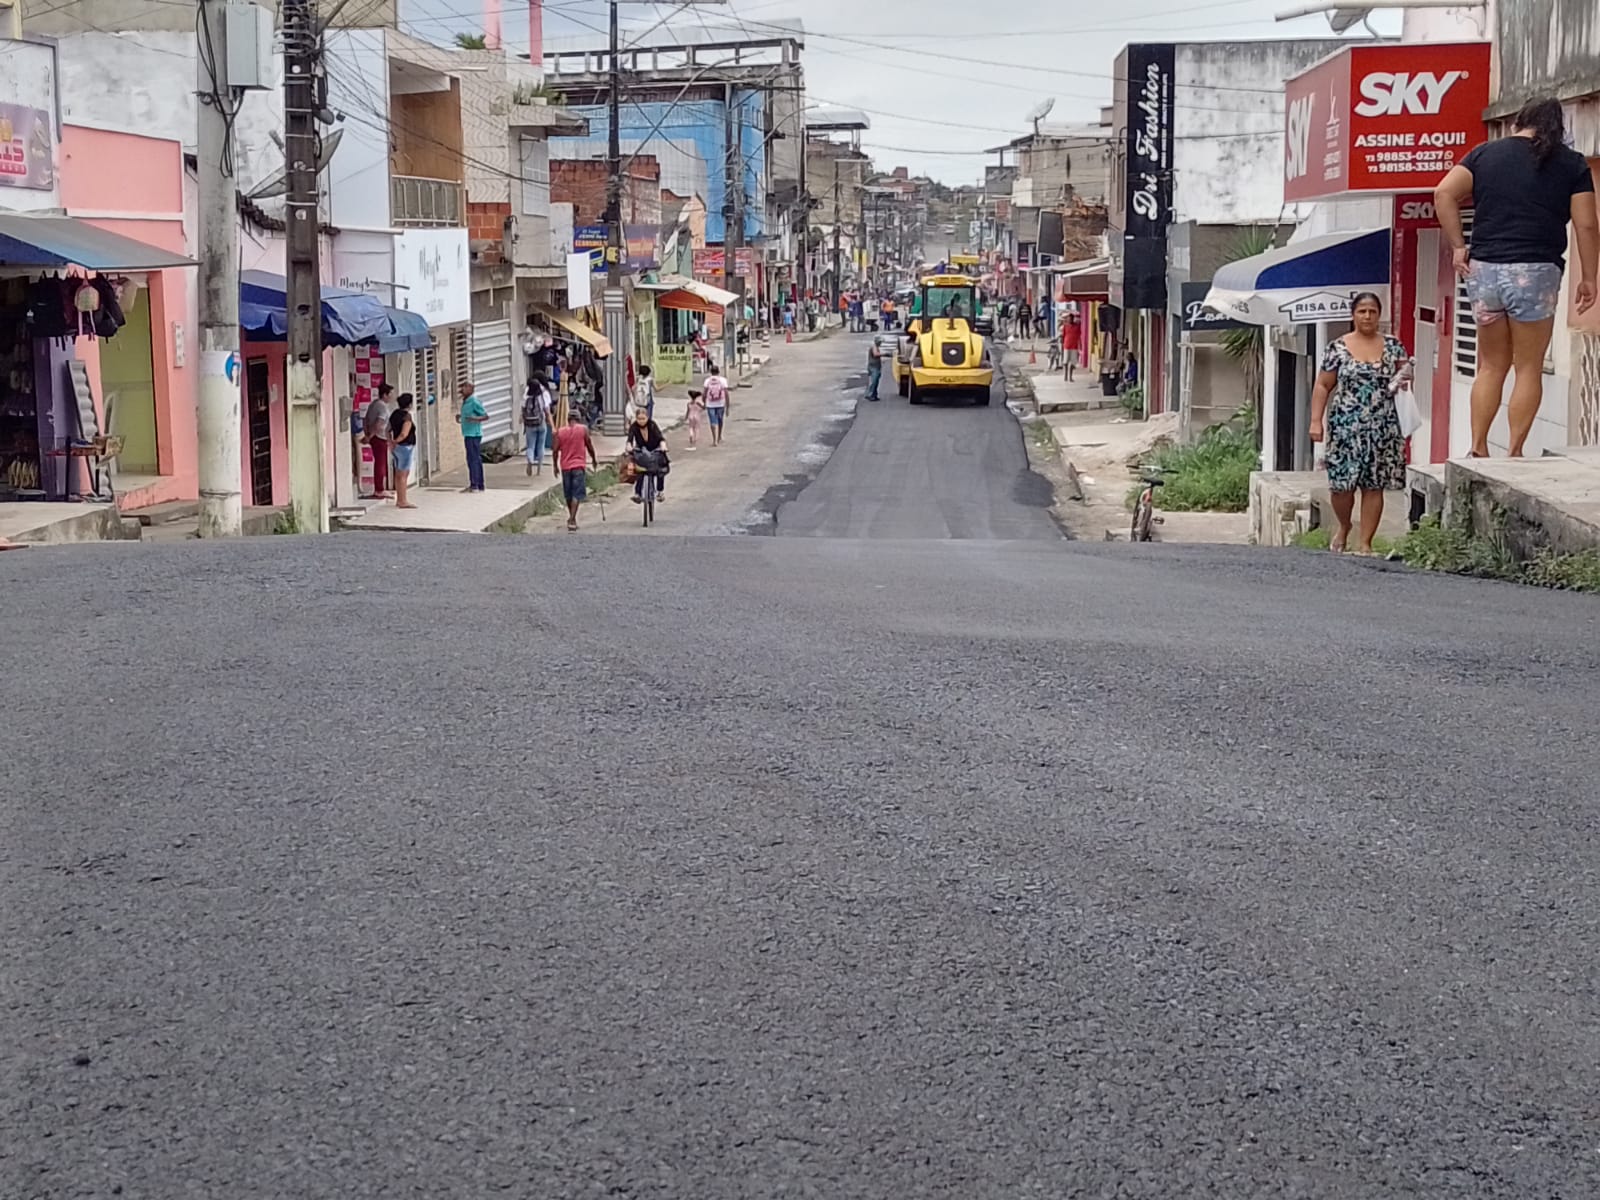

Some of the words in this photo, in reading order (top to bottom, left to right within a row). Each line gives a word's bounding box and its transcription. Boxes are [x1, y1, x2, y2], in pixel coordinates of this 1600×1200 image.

[1135, 62, 1160, 162] Fashion
[1354, 133, 1415, 147] ASSINE
[1418, 132, 1466, 147] AQUI!
[1132, 172, 1158, 221] Dri
